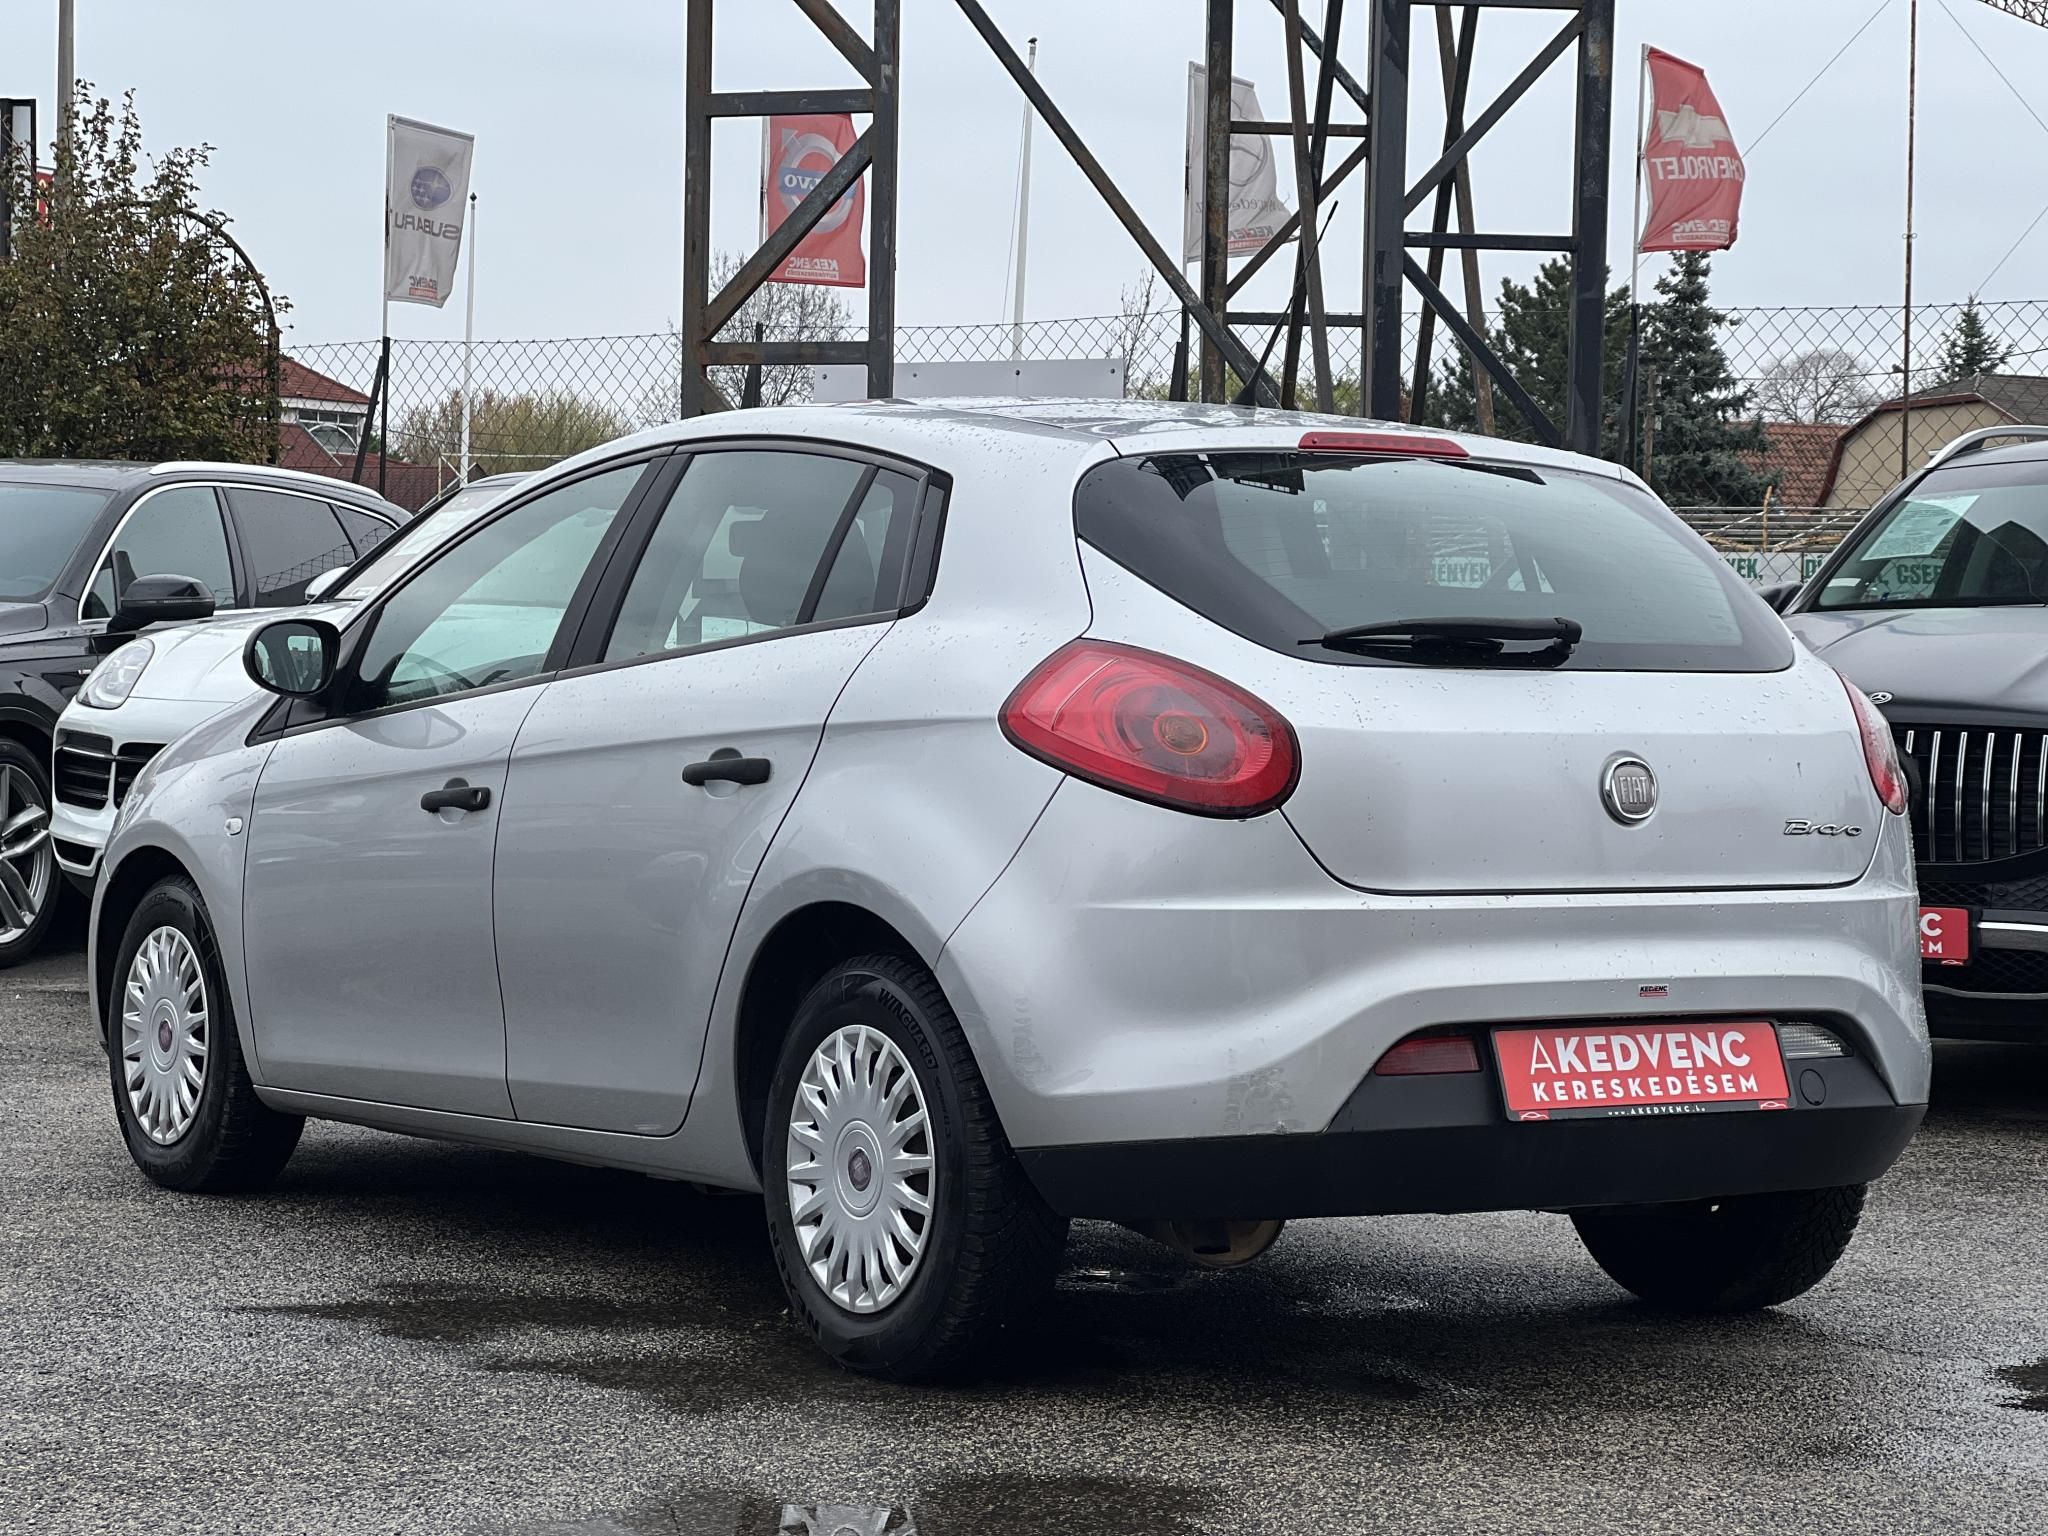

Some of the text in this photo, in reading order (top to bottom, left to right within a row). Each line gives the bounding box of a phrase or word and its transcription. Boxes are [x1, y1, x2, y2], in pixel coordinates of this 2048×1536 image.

[1618, 776, 1648, 804] FIAT
[1783, 819, 1863, 836] Bravo
[878, 987, 938, 1069] WINGUARD
[1532, 1069, 1759, 1102] KERESKEDÉSEM
